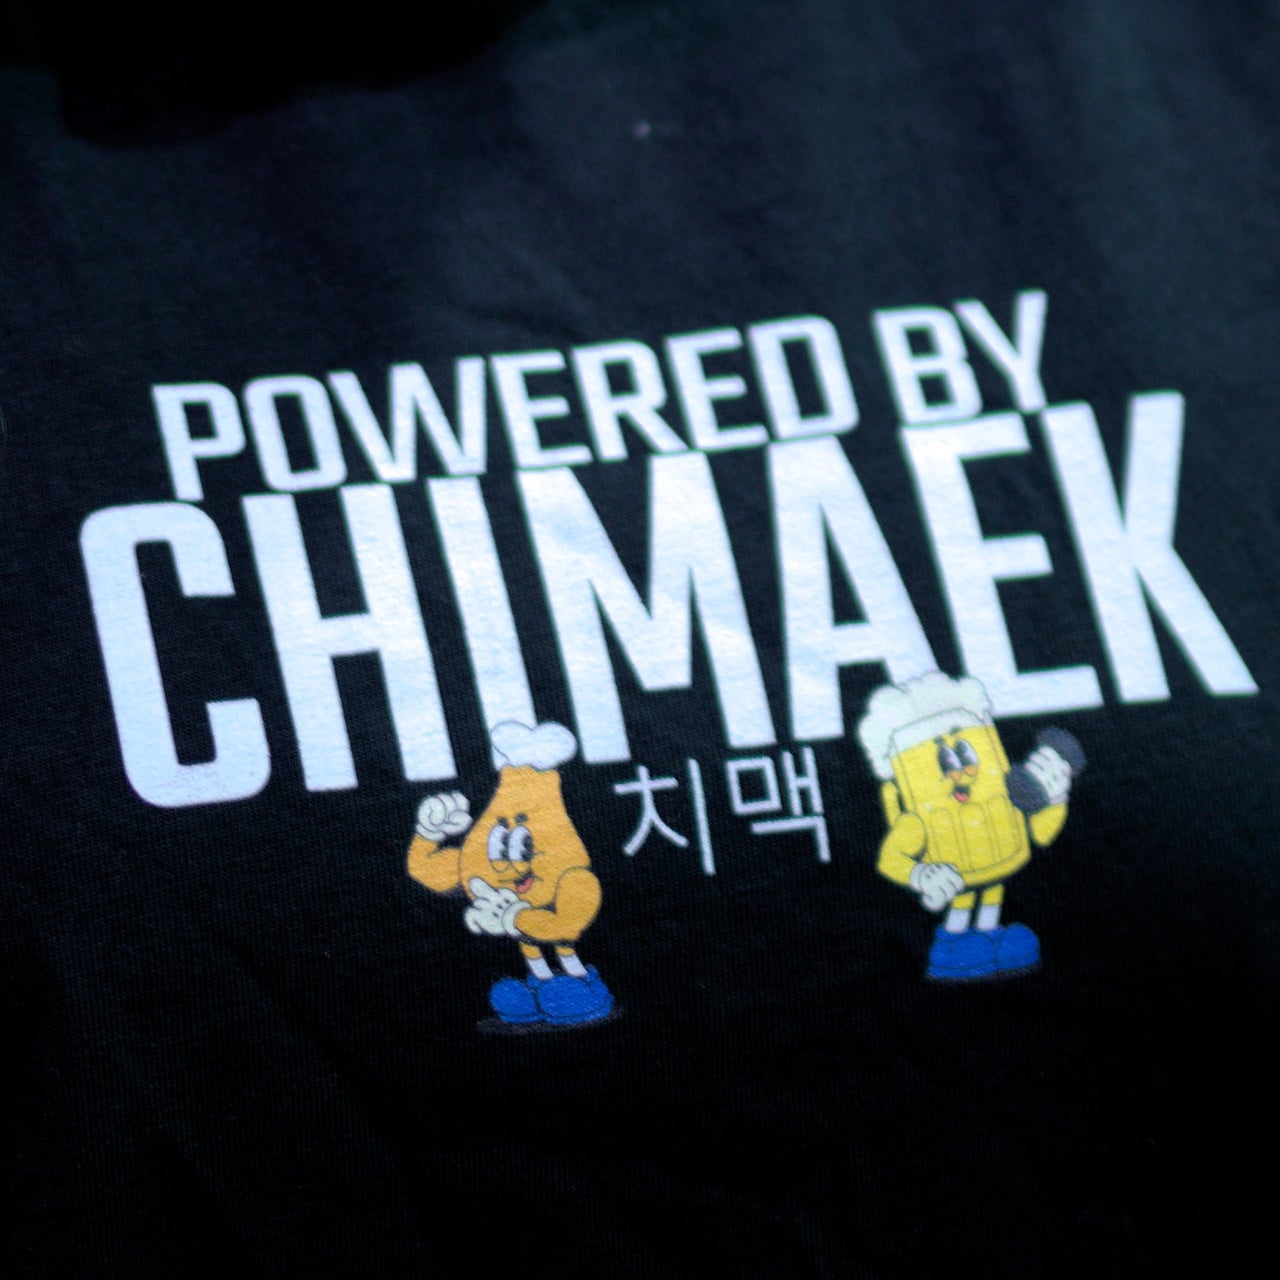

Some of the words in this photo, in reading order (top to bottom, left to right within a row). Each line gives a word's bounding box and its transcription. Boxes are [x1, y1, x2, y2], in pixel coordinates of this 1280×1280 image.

[151, 313, 860, 501] POWERED
[871, 288, 1048, 428] BY
[80, 391, 1260, 809] CHIMAEK
[613, 746, 832, 876] 치맥
